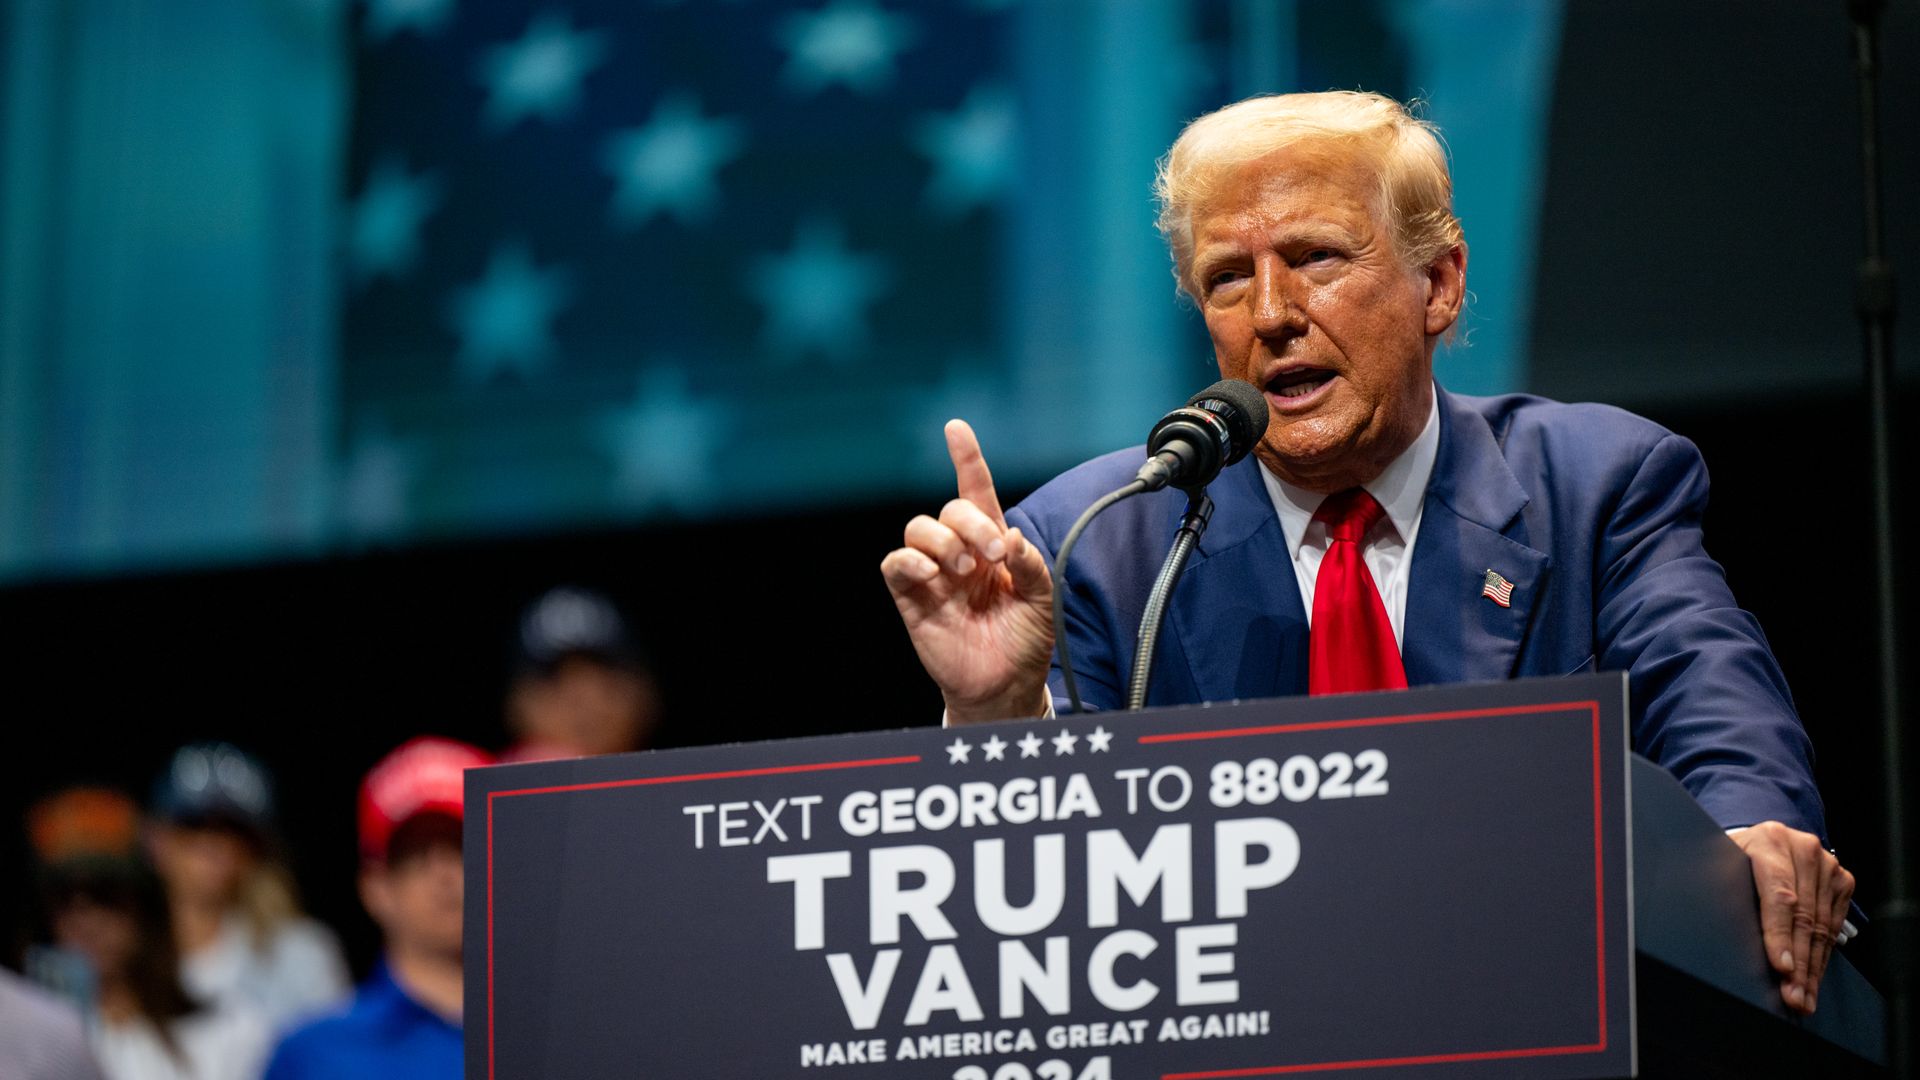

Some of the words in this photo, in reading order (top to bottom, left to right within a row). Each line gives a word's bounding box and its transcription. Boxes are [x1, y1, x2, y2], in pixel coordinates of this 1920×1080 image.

[682, 795, 823, 849] TEXT
[838, 773, 1102, 837] GEORGIA
[1114, 765, 1193, 815] TO
[1209, 748, 1389, 808] 88022
[766, 817, 1301, 951] TRUMP
[825, 923, 1240, 1030] VANCE
[800, 1039, 887, 1068] MAKE
[895, 1028, 1037, 1061] AMERICA
[1046, 1019, 1149, 1050] GREAT
[1158, 1010, 1270, 1042] AGAIN!
